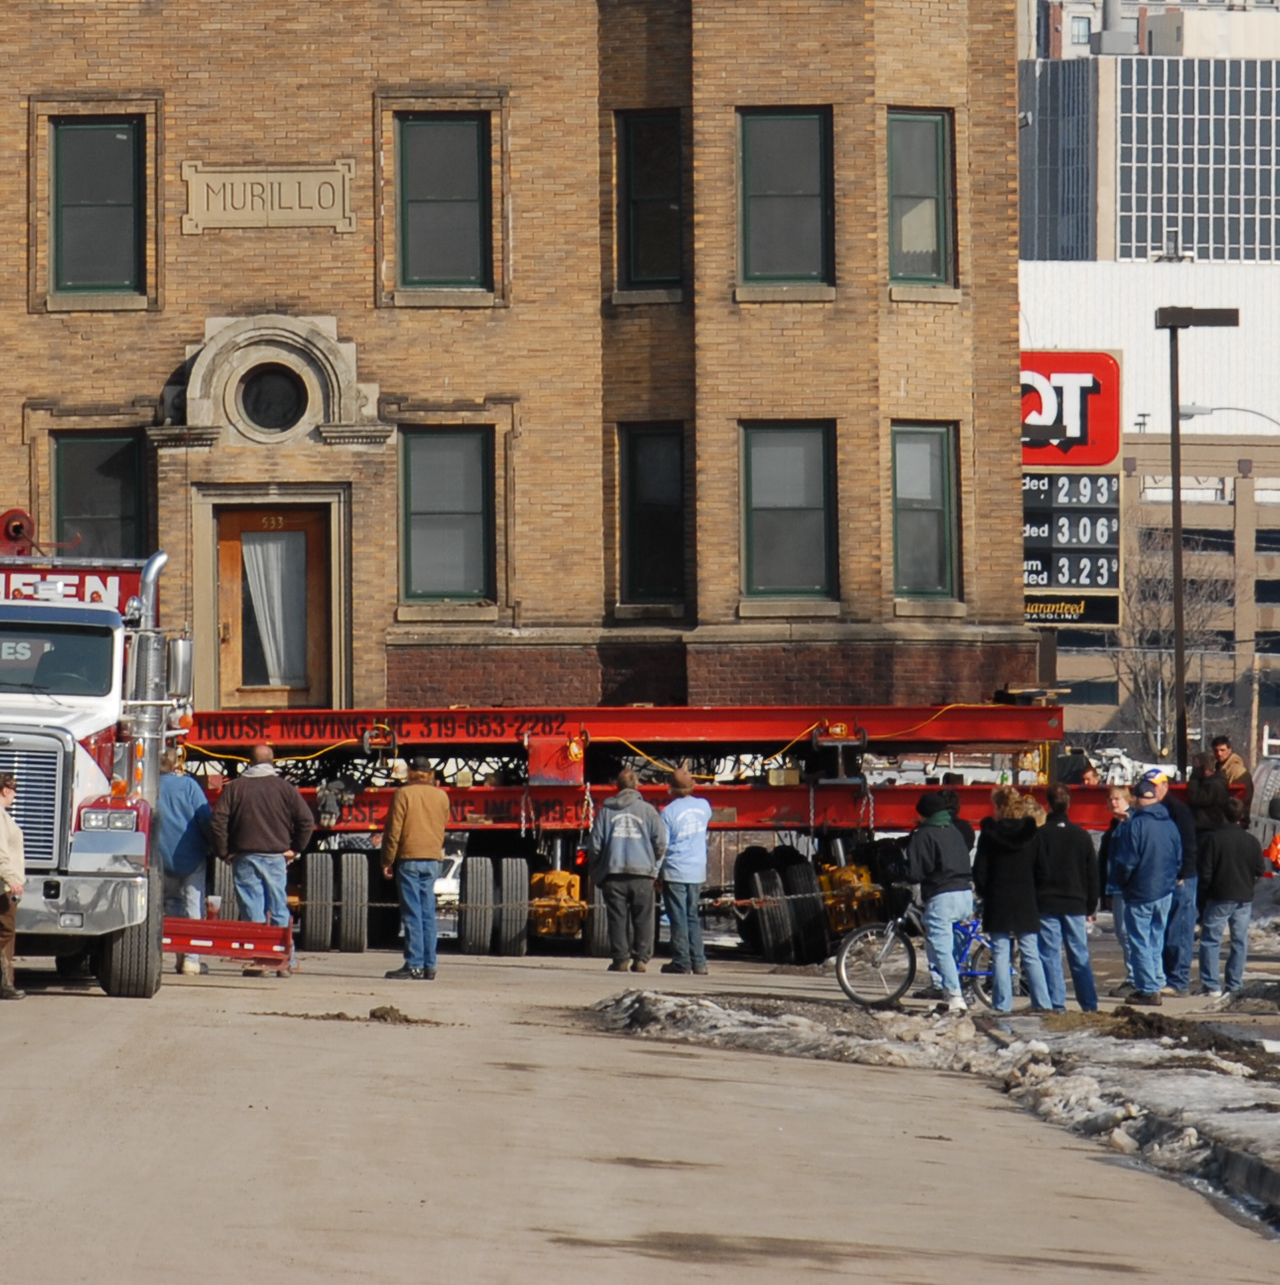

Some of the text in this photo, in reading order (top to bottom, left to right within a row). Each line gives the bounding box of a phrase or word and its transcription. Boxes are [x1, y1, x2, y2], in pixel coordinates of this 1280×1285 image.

[205, 181, 336, 211] MURILLO
[262, 516, 284, 529] 533
[198, 715, 271, 741] HOUSE
[280, 715, 367, 740] MOVING
[420, 714, 566, 738] 319-653-2282
